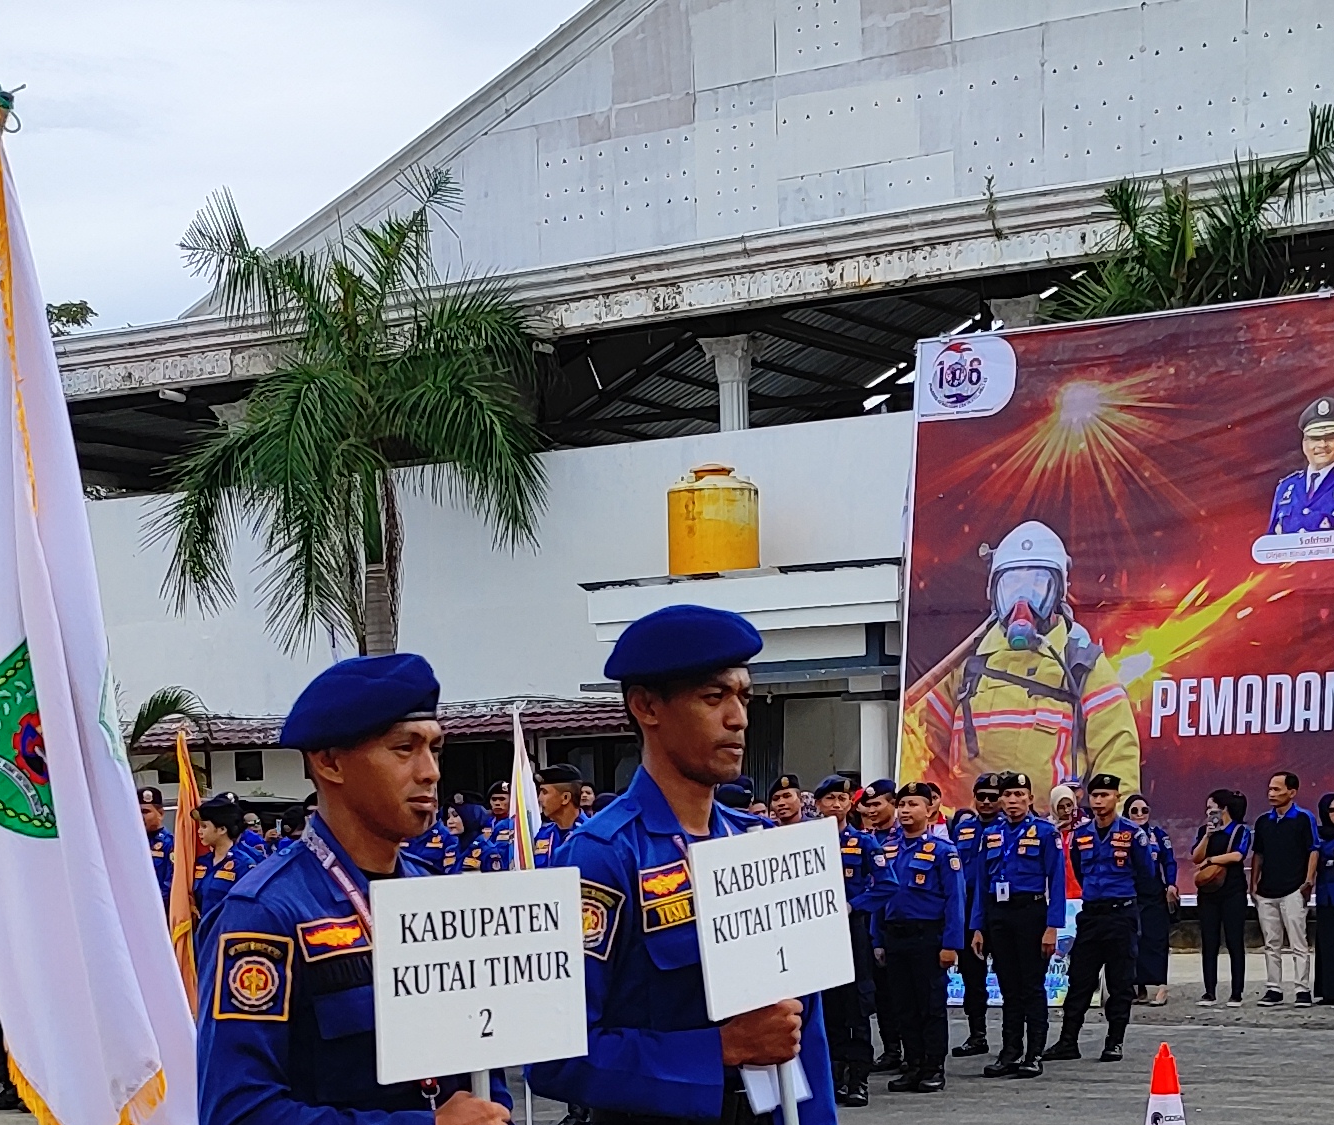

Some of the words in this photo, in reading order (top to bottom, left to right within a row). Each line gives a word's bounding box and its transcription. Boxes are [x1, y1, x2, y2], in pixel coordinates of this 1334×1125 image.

[713, 846, 827, 898] KABUPATEN
[399, 901, 560, 945] KABUPATEN
[713, 904, 773, 945] KUTAI
[775, 889, 839, 928] TIMUR
[392, 959, 477, 998] KUTAI
[484, 950, 572, 988] TIMUR
[776, 945, 789, 974] 1
[479, 1008, 494, 1038] 2
